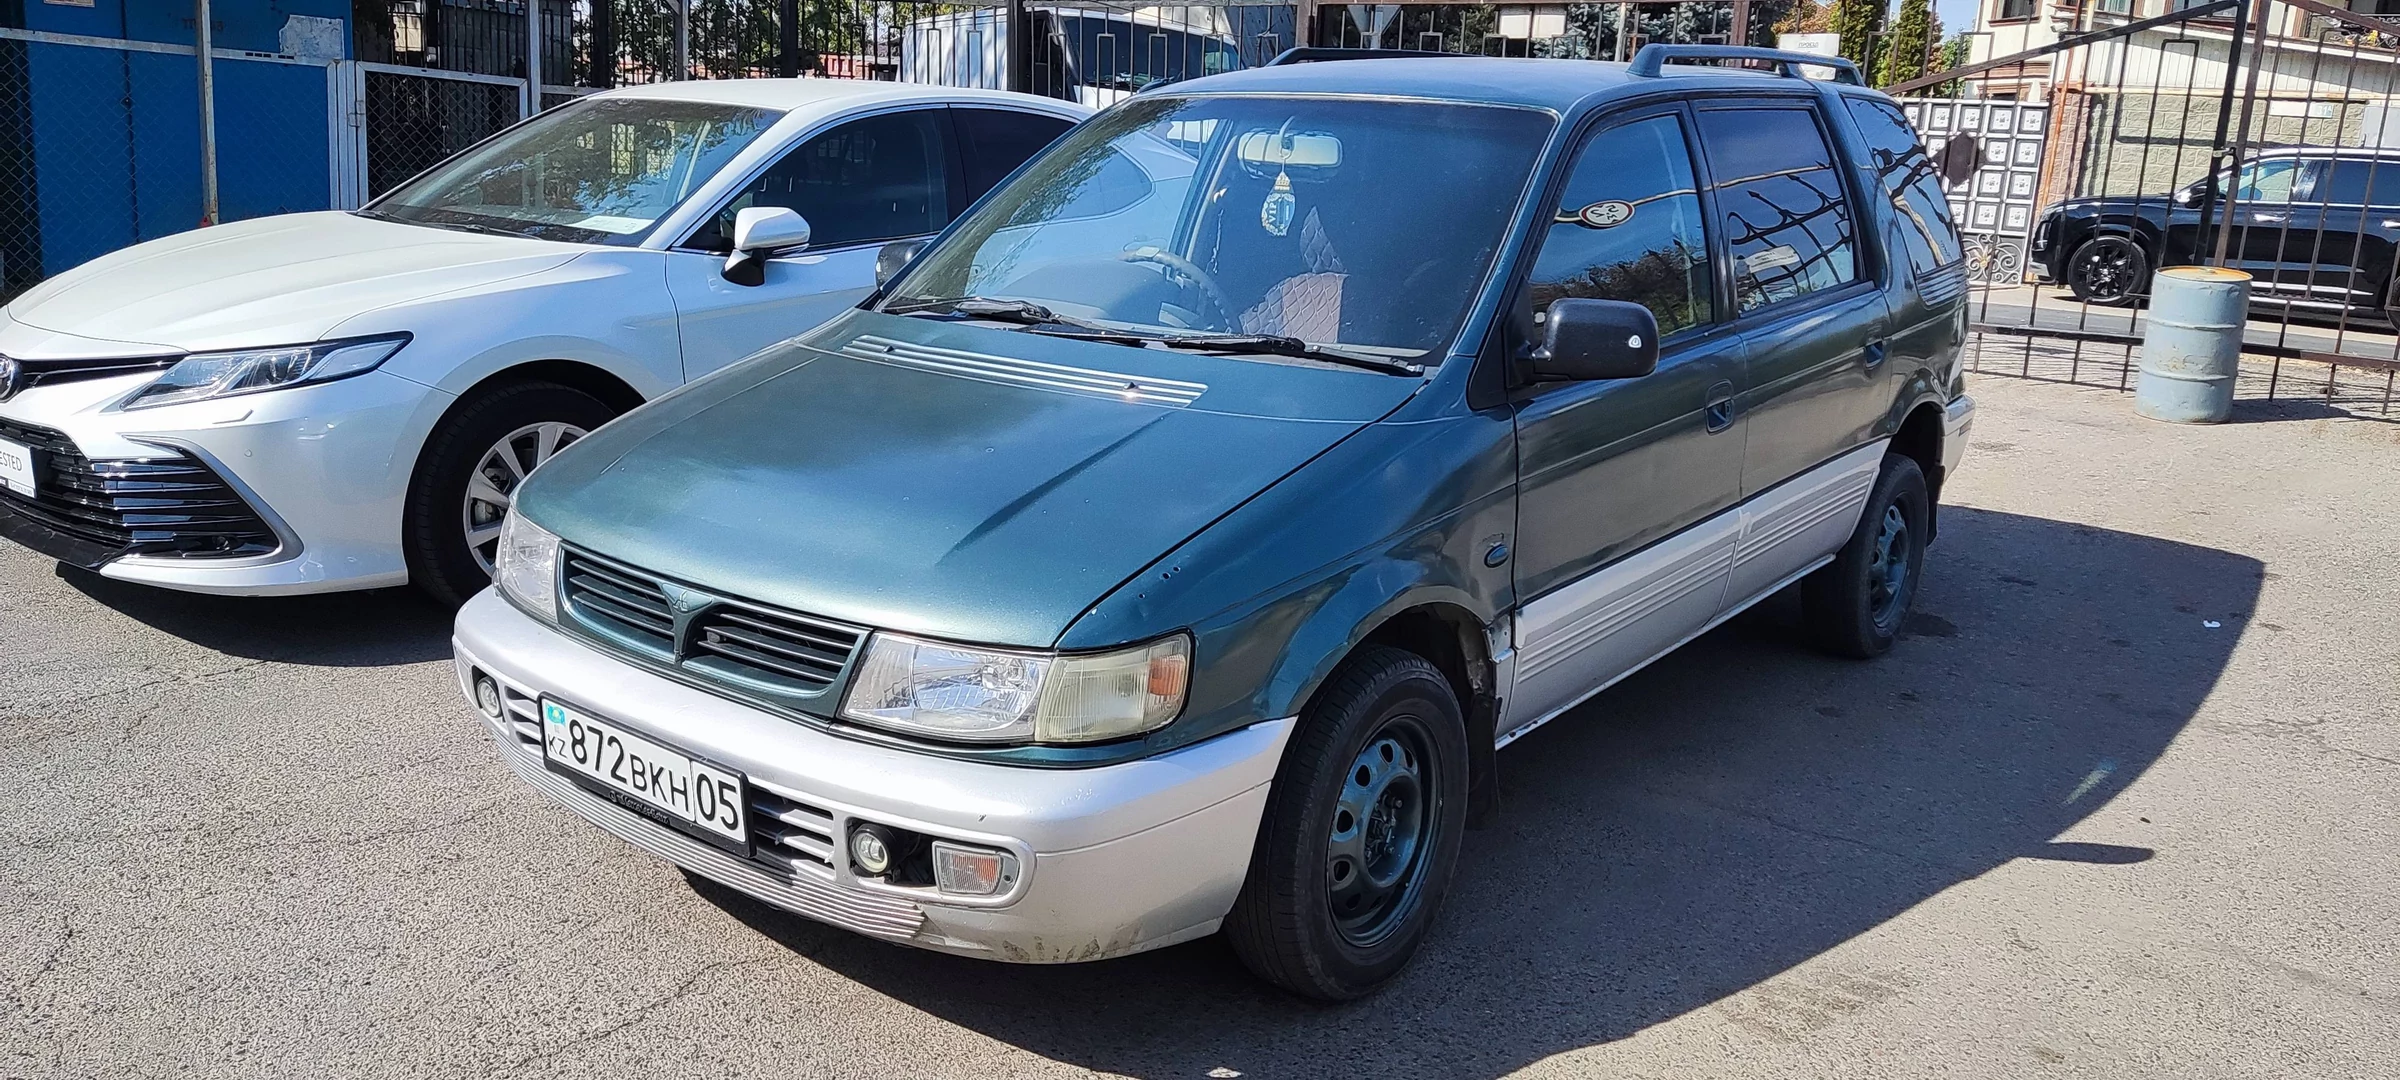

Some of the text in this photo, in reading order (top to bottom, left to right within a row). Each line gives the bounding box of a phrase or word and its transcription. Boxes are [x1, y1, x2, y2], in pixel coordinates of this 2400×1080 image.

[1268, 202, 1277, 223] VIP
[547, 733, 568, 759] KZ
[696, 772, 739, 831] 05
